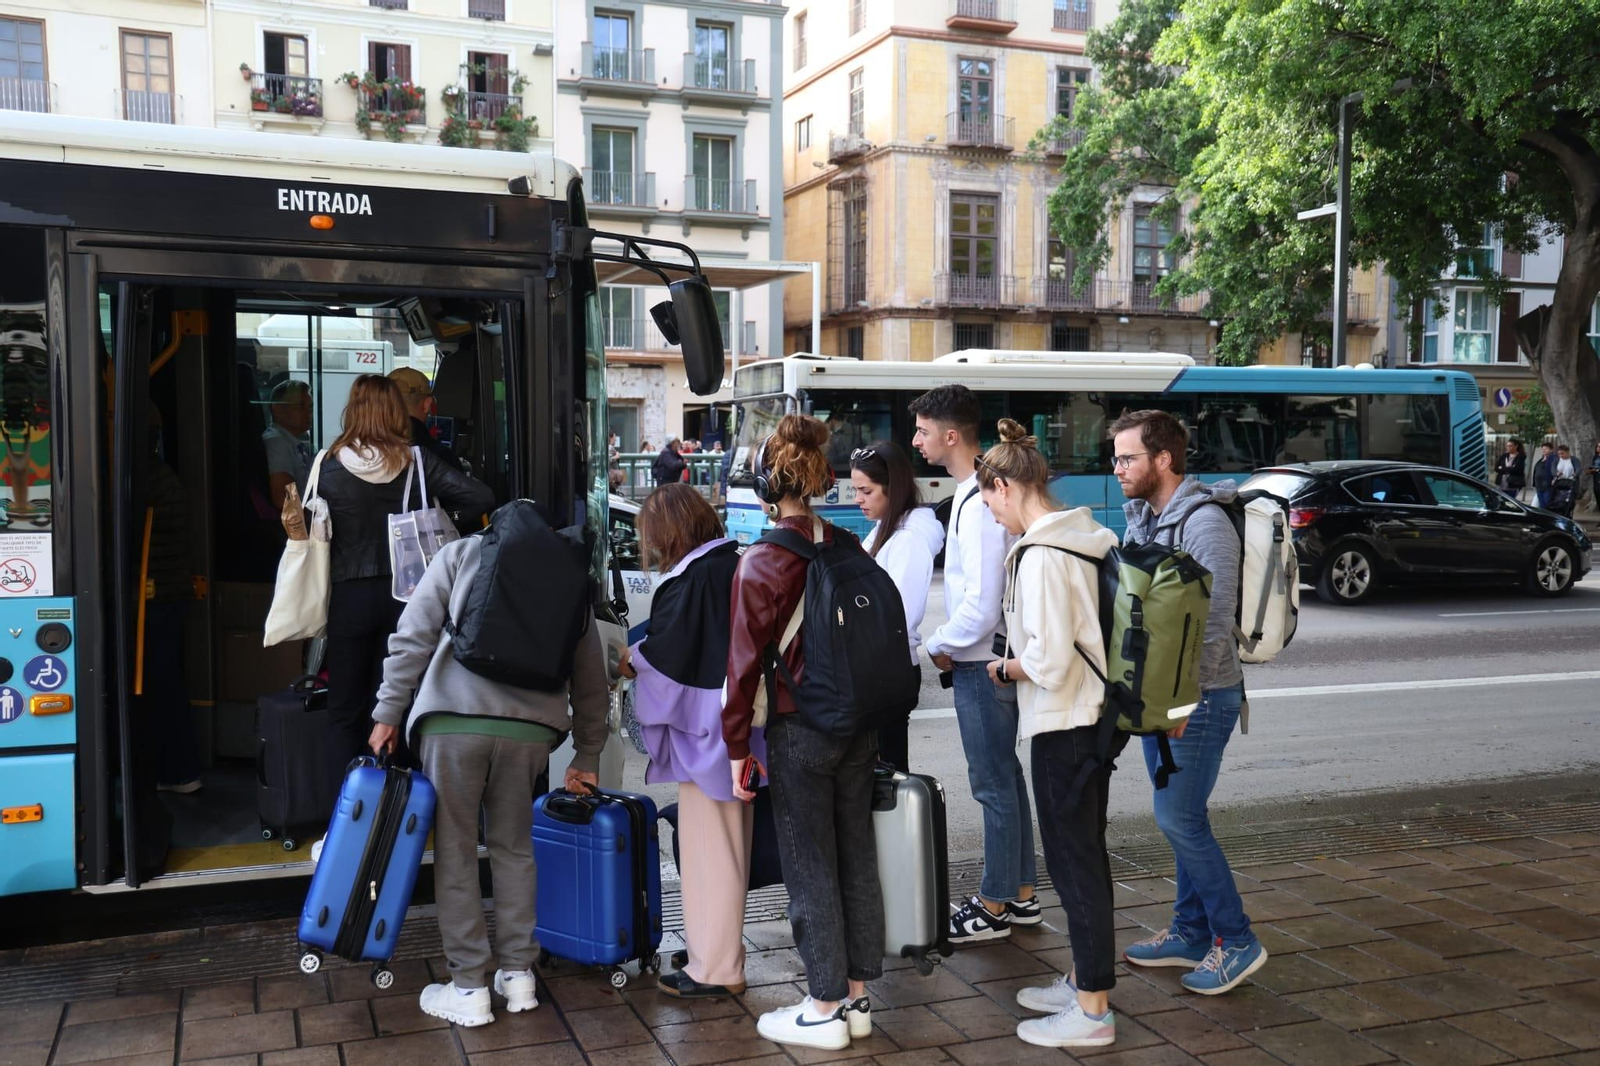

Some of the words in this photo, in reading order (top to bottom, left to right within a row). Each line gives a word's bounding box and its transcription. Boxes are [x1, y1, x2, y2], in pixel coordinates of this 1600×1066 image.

[278, 188, 373, 216] ENTRADA
[355, 352, 377, 364] 722
[627, 577, 652, 585] TAXI
[630, 585, 650, 594] 766
